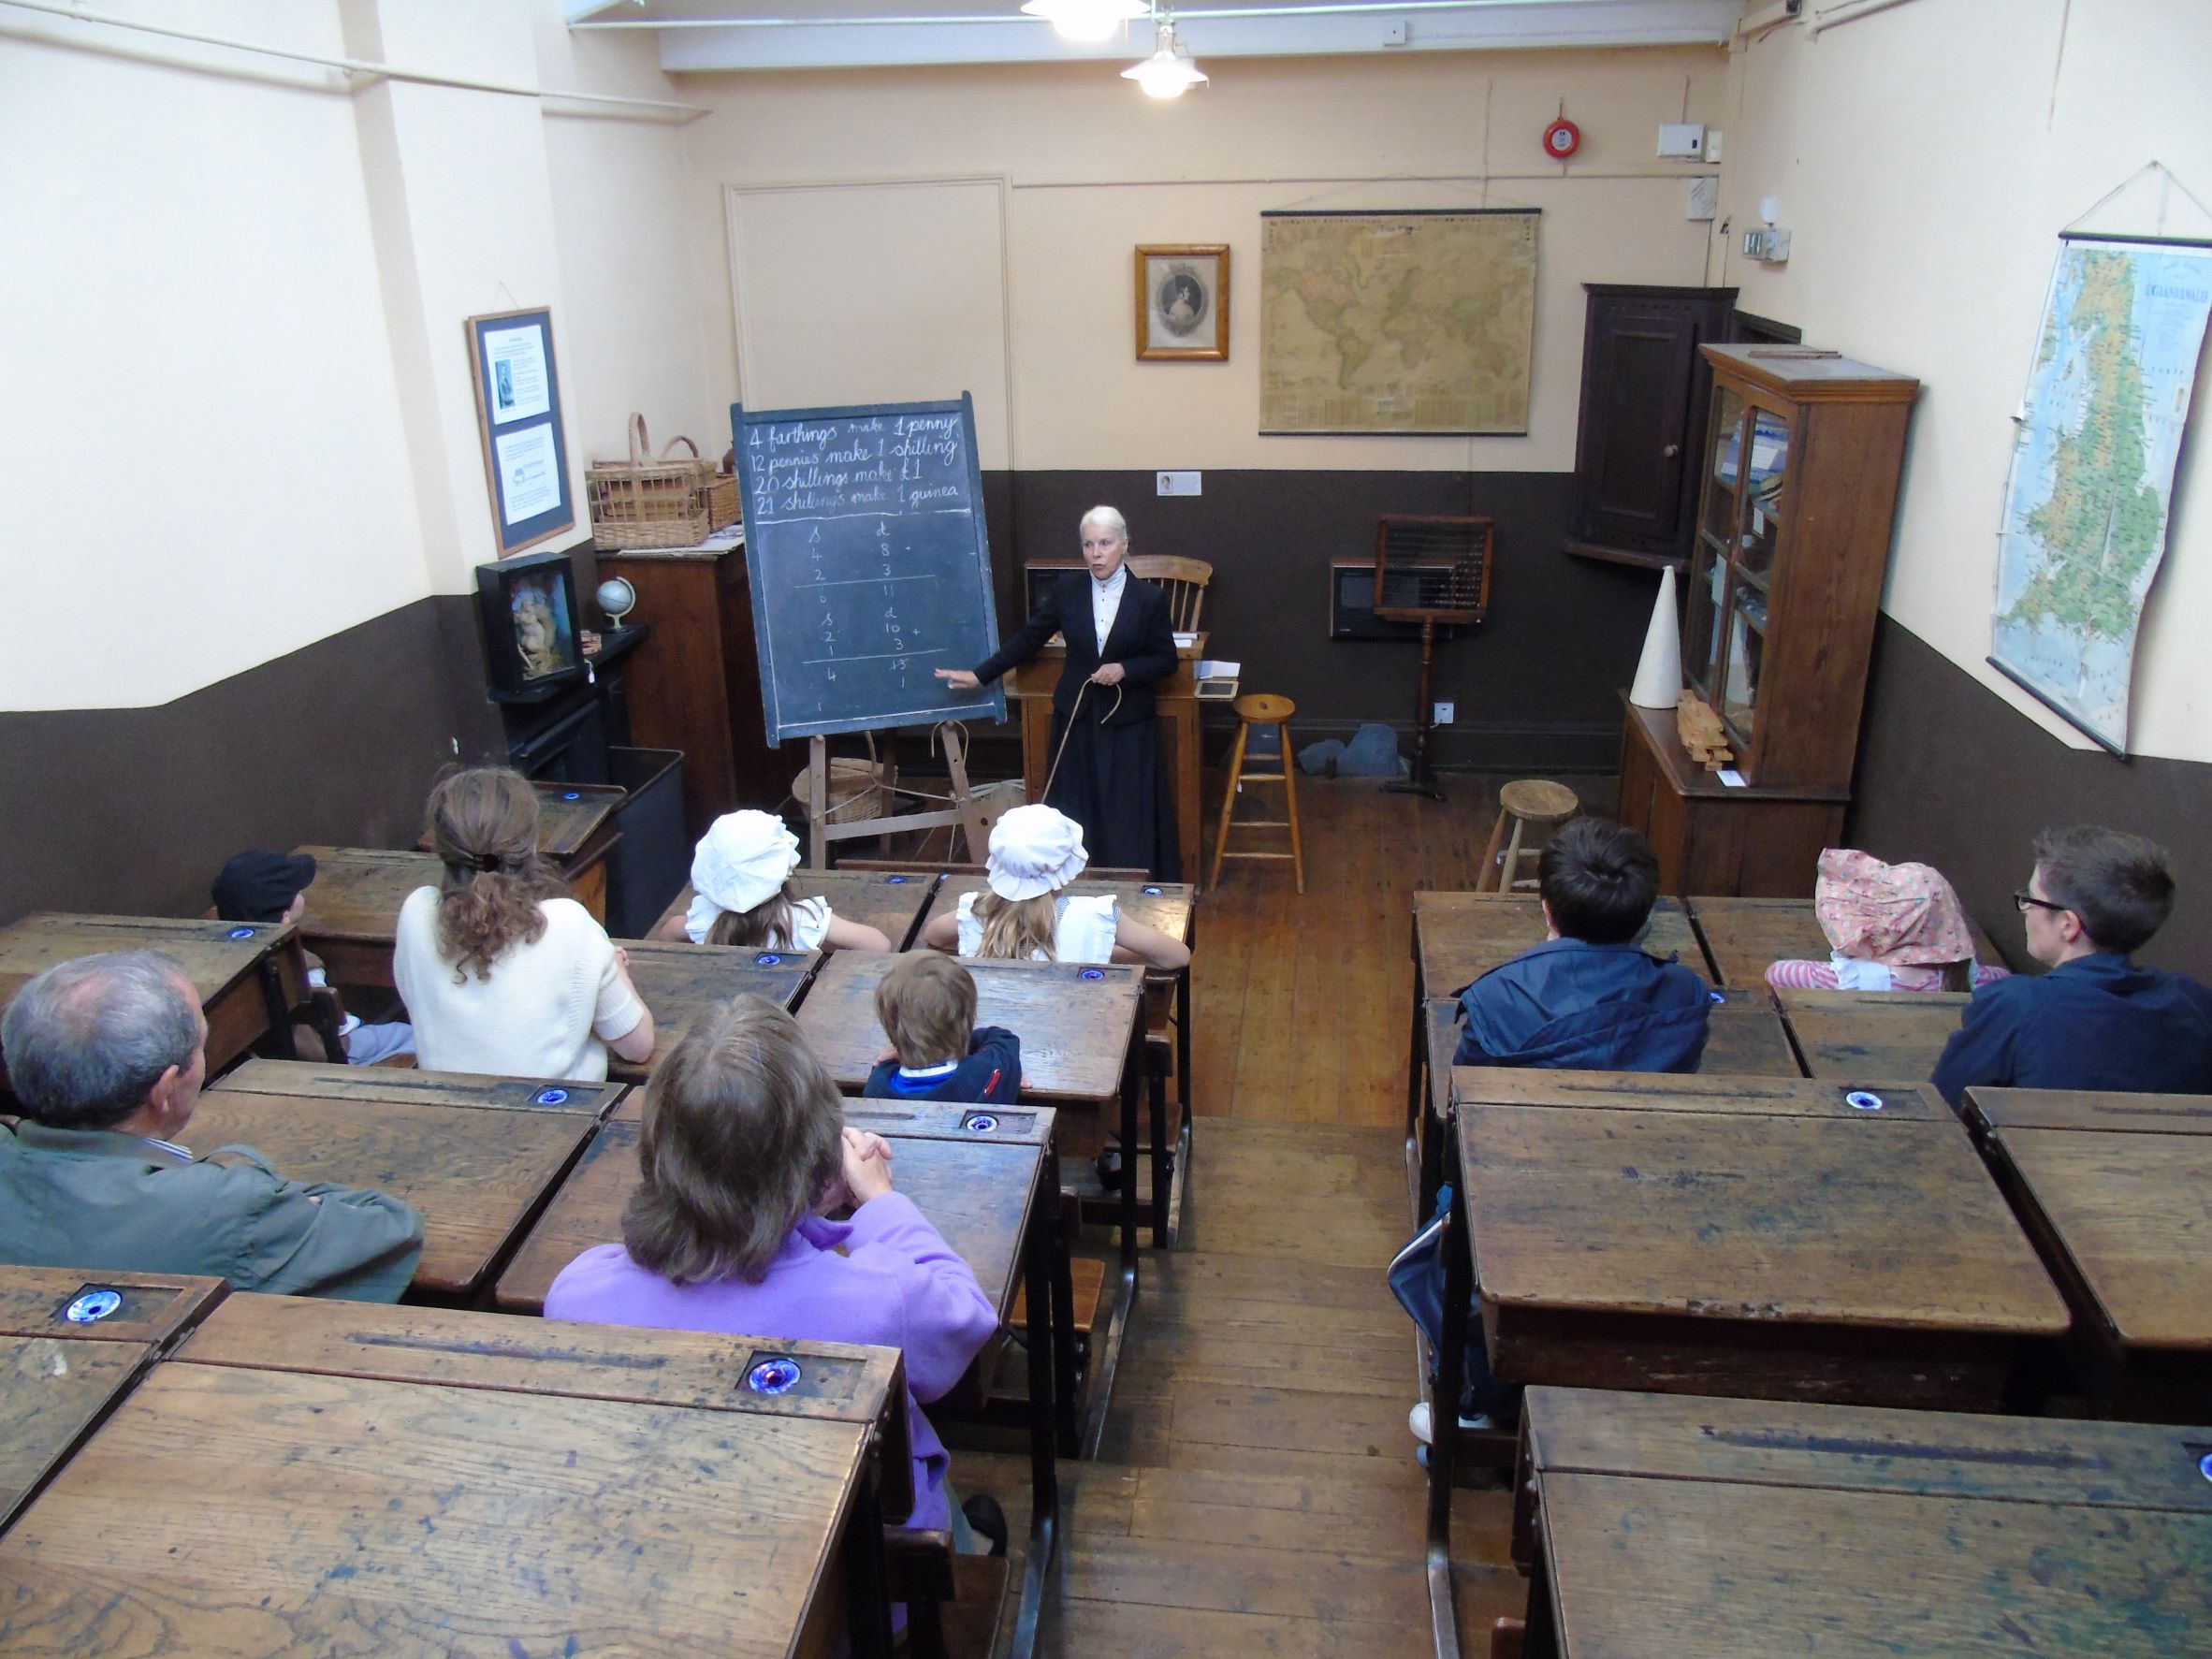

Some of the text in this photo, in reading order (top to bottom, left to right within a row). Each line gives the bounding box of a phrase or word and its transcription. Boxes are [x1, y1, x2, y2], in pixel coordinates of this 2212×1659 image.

[749, 416, 958, 453] 4 farthings make 1 penny
[751, 433, 958, 476] 12 pennies make 1 shilling
[754, 475, 779, 495] 20
[852, 460, 892, 483] make
[757, 483, 958, 516] 21 shillings make 1 guinea
[811, 546, 823, 561] 4
[880, 542, 890, 557] 8
[813, 563, 891, 580] 2 3
[824, 631, 837, 642] 2
[885, 622, 900, 633] 10
[894, 638, 904, 650] 3
[827, 666, 837, 681] 4
